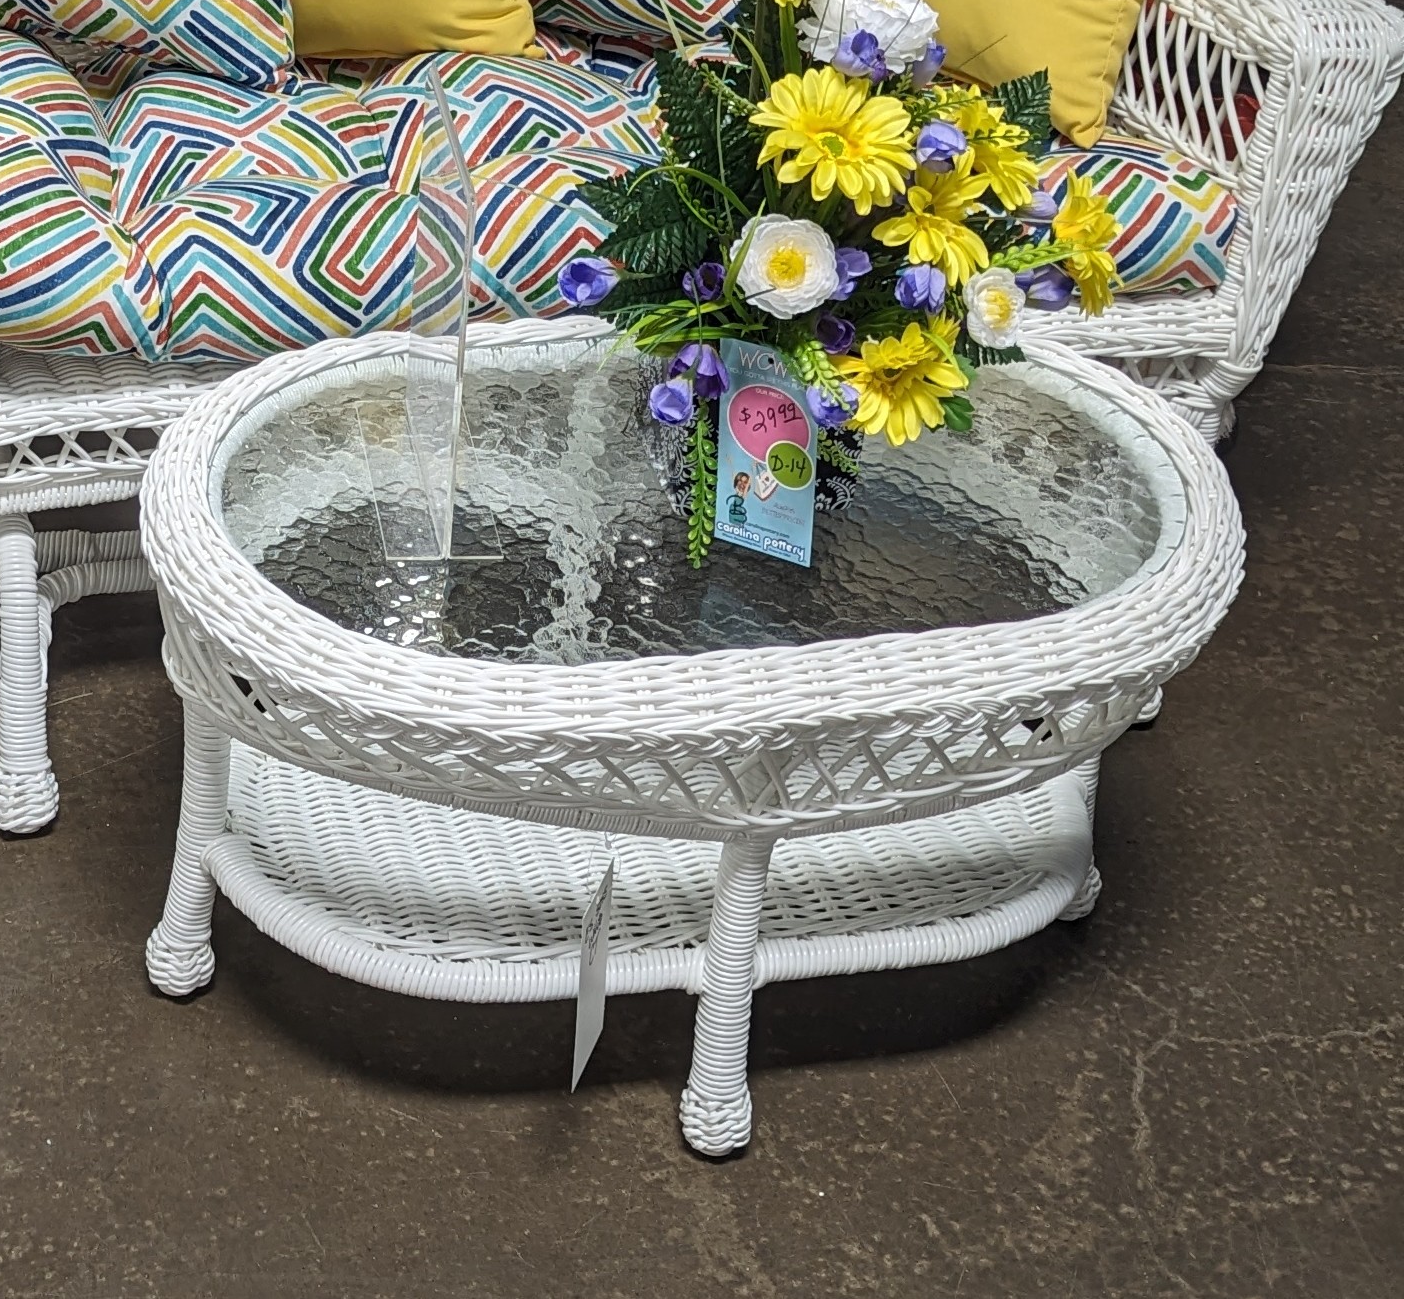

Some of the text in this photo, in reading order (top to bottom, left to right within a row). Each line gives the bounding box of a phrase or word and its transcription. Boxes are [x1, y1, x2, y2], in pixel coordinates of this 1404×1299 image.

[770, 454, 807, 480] D-14
[716, 521, 761, 543] carolina
[763, 536, 806, 563] pottery
